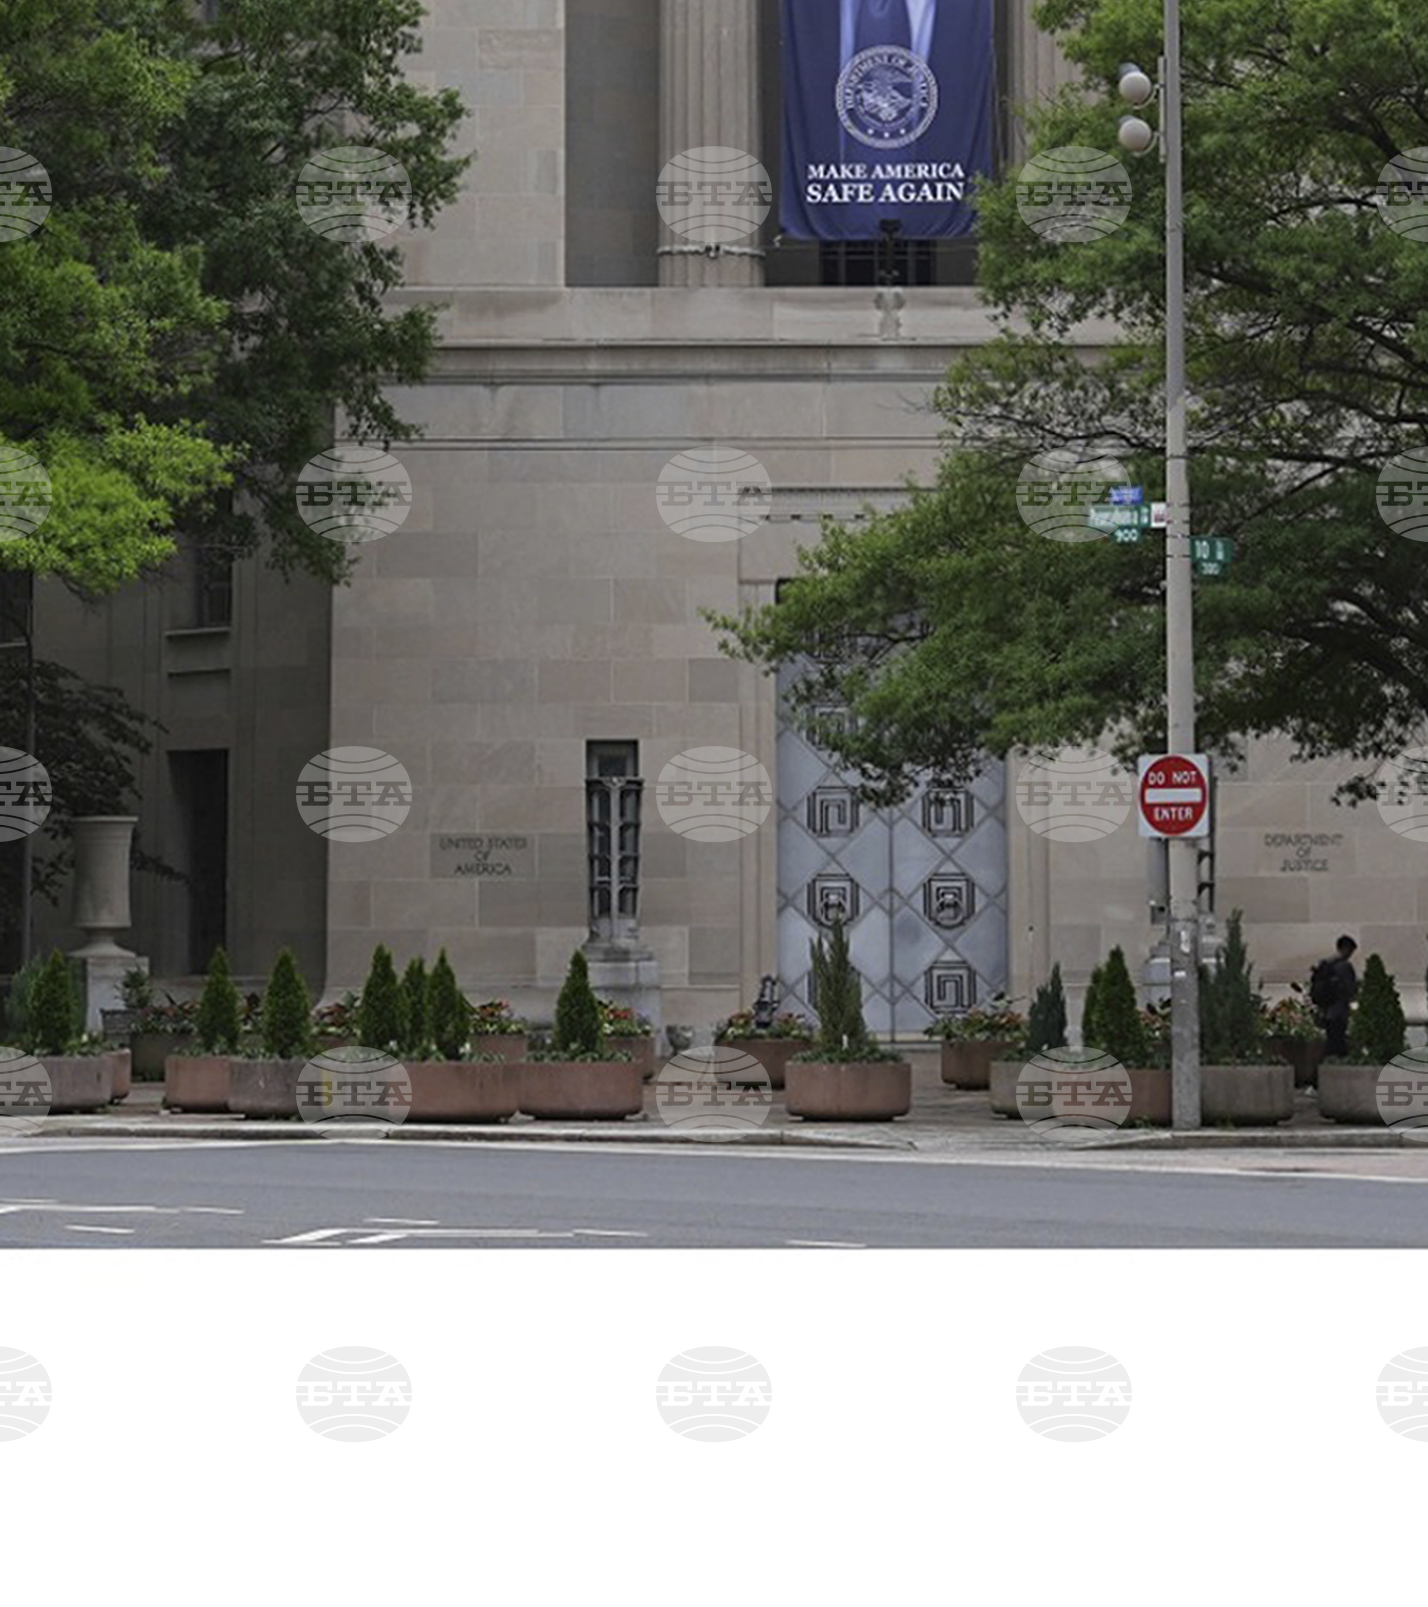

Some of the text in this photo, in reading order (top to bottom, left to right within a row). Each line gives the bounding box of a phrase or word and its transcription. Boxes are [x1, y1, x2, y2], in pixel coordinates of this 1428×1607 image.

[807, 162, 965, 180] MAKE AMERICA
[806, 181, 966, 204] SAFE AGAIN
[1148, 771, 1197, 786] DO NOT
[1153, 806, 1193, 821] ENTER
[439, 837, 484, 850] UNITED
[454, 862, 513, 876] AMERICA
